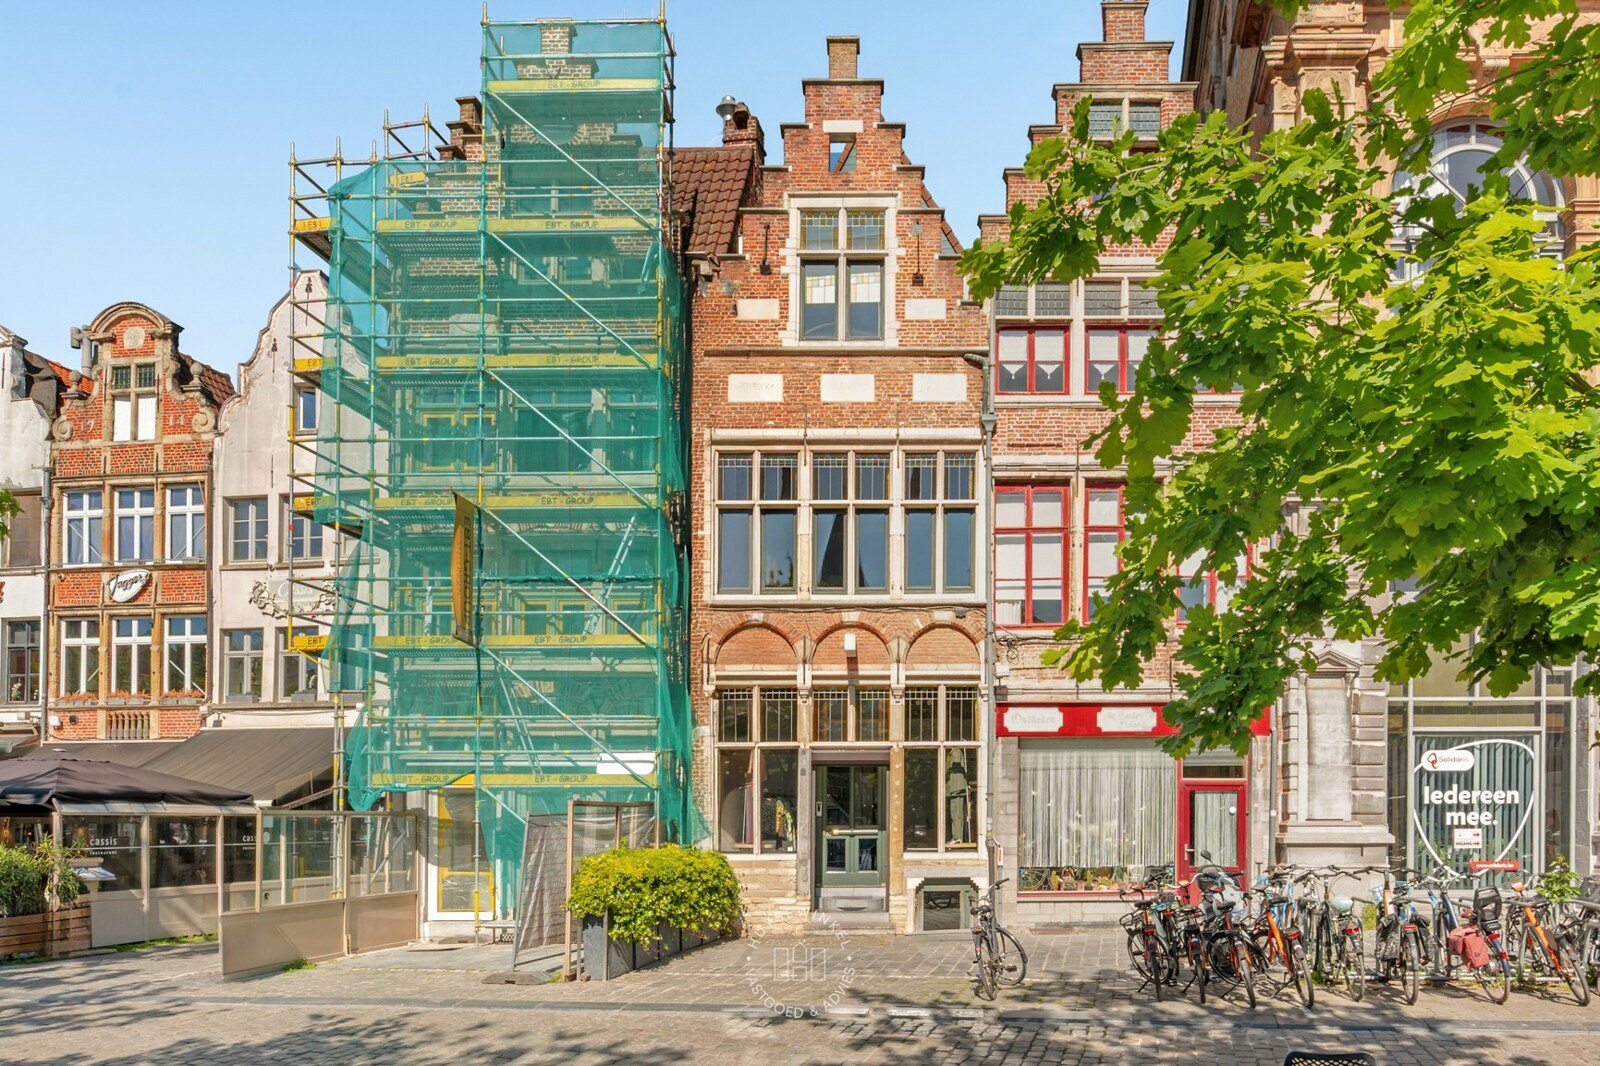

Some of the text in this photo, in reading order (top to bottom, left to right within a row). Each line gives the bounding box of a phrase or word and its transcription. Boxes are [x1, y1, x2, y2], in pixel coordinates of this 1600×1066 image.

[547, 80, 564, 88] EBT
[572, 80, 600, 88] GROUP
[400, 175, 414, 183] EBT
[306, 220, 323, 228] EBT
[404, 220, 422, 229] EBT
[428, 220, 458, 229] GROUP
[545, 220, 562, 229] EBT
[569, 220, 598, 229] GROUP
[405, 358, 422, 366] EBT
[429, 358, 458, 366] GROUP
[546, 356, 562, 364] EBT
[570, 356, 599, 364] GROUP
[306, 498, 321, 506] EBT
[541, 498, 558, 506] EBT
[565, 498, 594, 506] GROUP
[277, 581, 313, 598] Cssis
[307, 636, 322, 644] EBT
[406, 636, 422, 644] EBT
[534, 636, 551, 644] EBT
[558, 636, 588, 644] GROUP
[397, 775, 414, 783] EBT
[534, 775, 552, 783] EBT
[559, 775, 588, 783] GROUP
[1424, 784, 1520, 805] Iedereen
[1445, 810, 1498, 826] mee.
[89, 836, 118, 846] cassis
